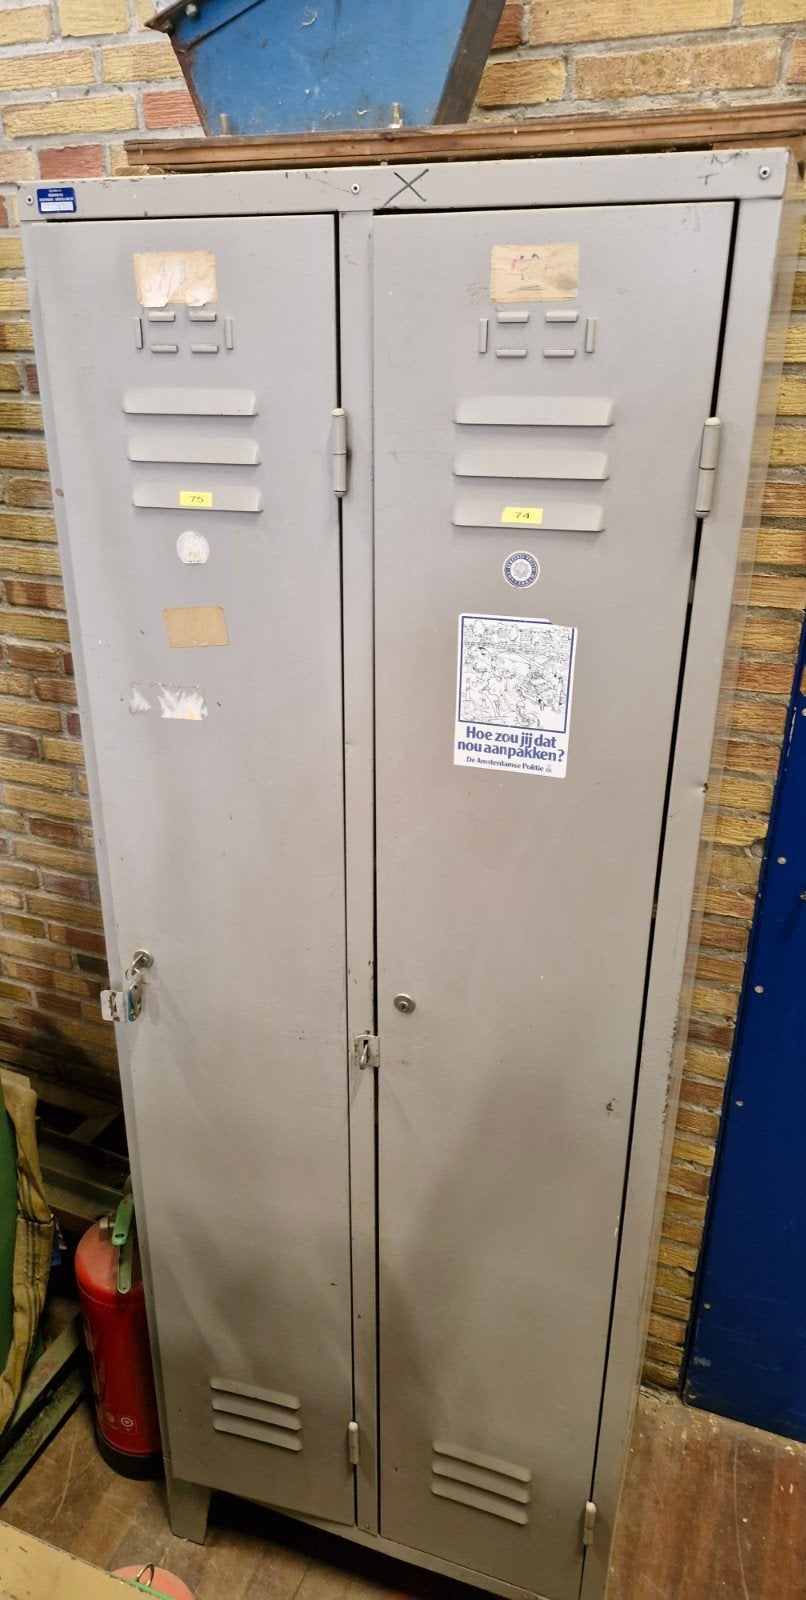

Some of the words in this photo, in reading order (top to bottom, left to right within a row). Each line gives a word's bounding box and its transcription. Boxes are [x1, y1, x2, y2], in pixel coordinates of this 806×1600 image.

[466, 726, 492, 740] Hoe
[494, 732, 518, 743] zou
[519, 732, 533, 748] jij
[534, 734, 557, 749] dat
[457, 741, 482, 752] nou
[483, 744, 565, 762] aanpakken?
[476, 757, 521, 769] Amsterdamse
[522, 763, 545, 772] Politie
